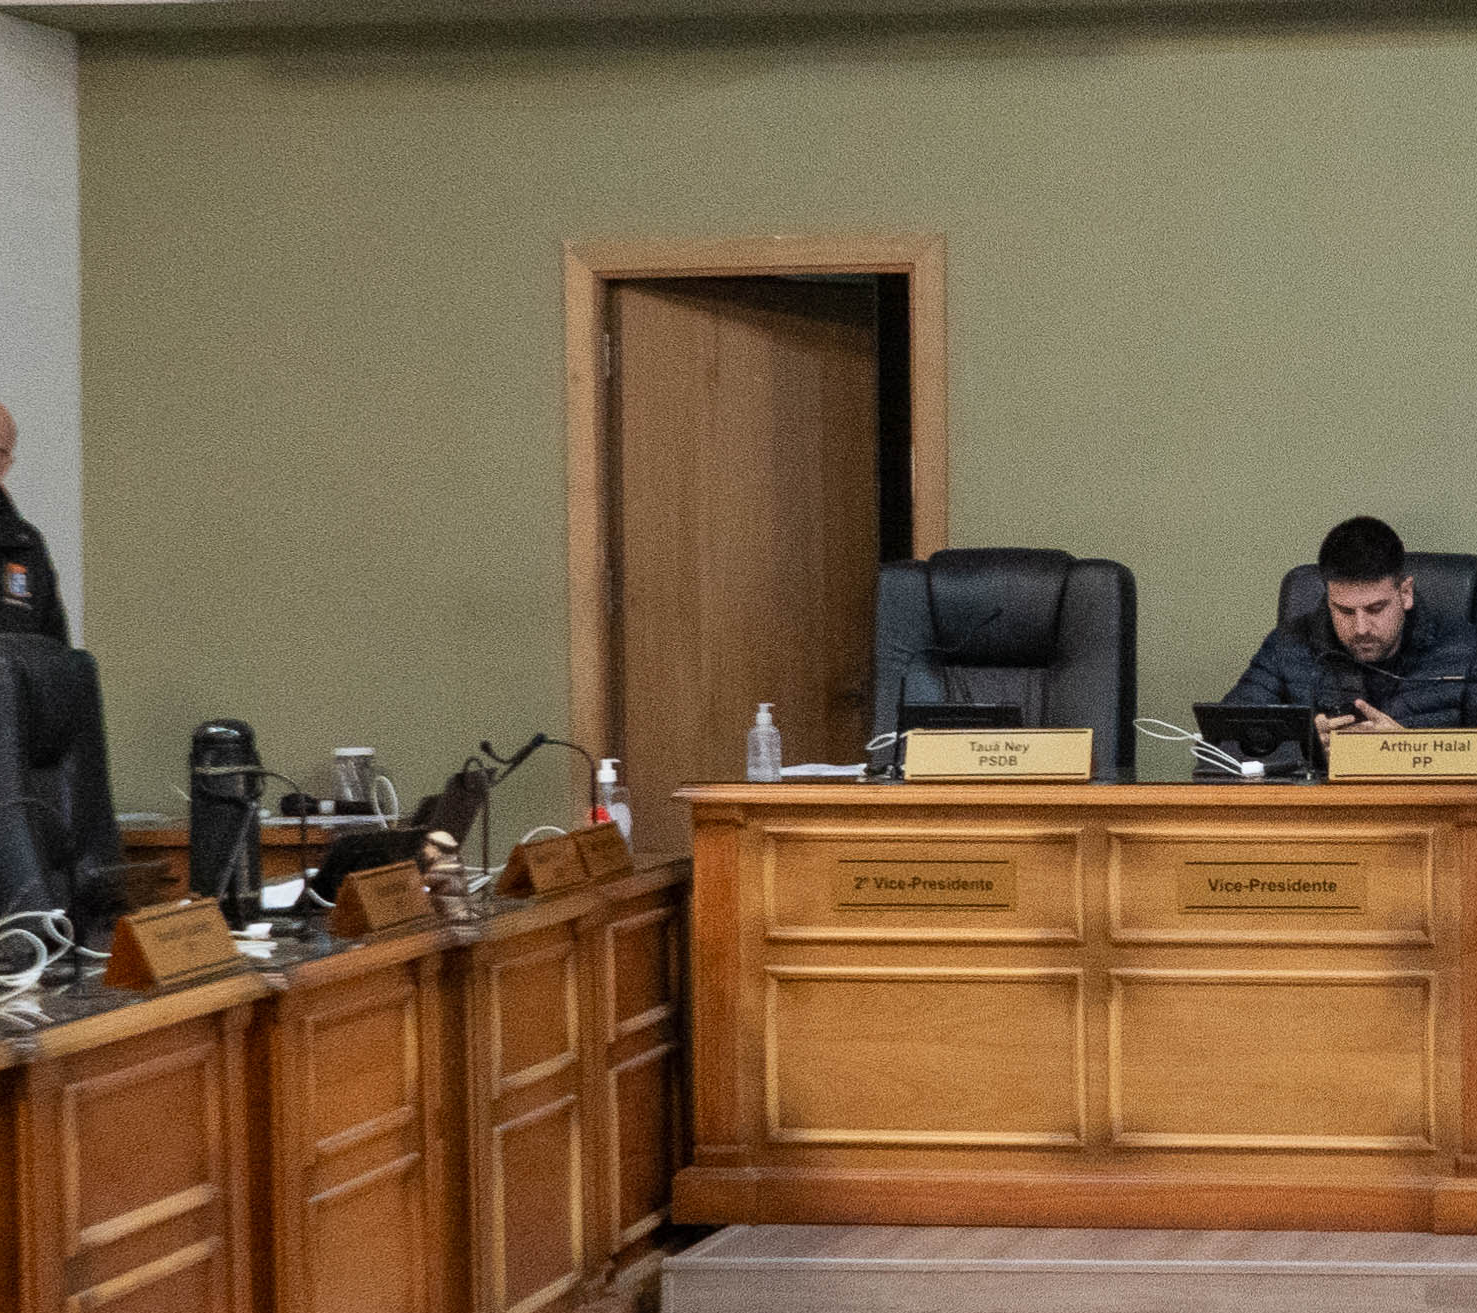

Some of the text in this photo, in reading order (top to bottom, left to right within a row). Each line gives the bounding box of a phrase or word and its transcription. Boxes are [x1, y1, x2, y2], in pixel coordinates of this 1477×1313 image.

[1004, 740, 1030, 757] Ney
[1379, 739, 1471, 753] Arthur Halal
[978, 755, 1018, 767] PSDB
[1412, 756, 1434, 768] PP
[872, 876, 994, 891] Vice-Presidente
[1207, 877, 1338, 893] Vice-Presidente
